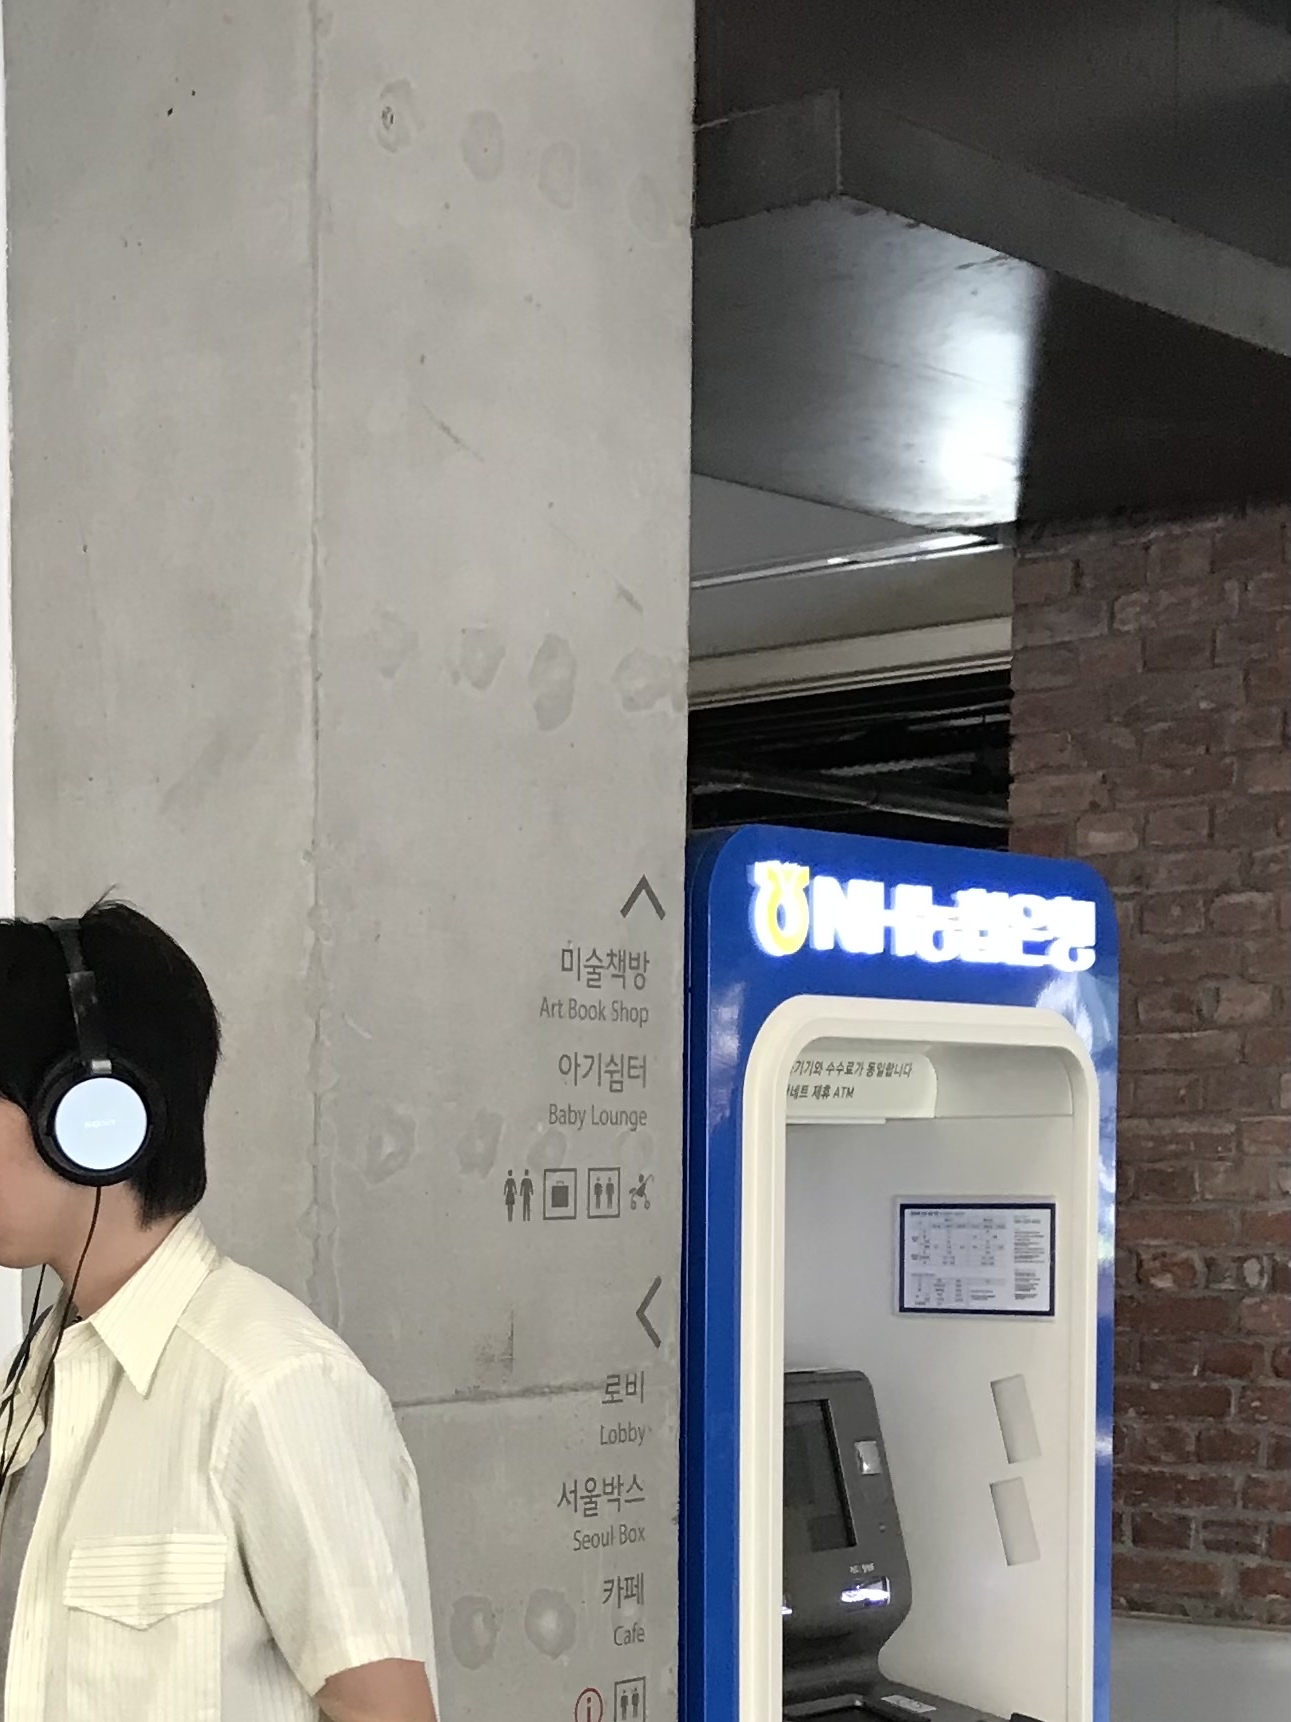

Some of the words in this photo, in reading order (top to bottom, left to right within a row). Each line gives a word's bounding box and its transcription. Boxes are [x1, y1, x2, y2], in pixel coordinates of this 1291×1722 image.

[560, 946, 651, 991] 미술책방
[539, 996, 564, 1020] Art
[567, 998, 607, 1023] Book
[611, 1000, 649, 1028] Shop
[558, 1051, 647, 1093] 아기쉼터
[789, 1060, 823, 1077] 기기와
[787, 1084, 809, 1100] 네트
[833, 1086, 855, 1100] ATM
[548, 1103, 587, 1131] Baby
[591, 1104, 648, 1132] Lounge
[601, 1370, 645, 1405] 로비
[600, 1423, 646, 1447] Lobby
[556, 1473, 646, 1518] 서울박스
[572, 1525, 614, 1552] Seoul
[618, 1522, 646, 1546] Box
[602, 1572, 645, 1609] 카페
[613, 1622, 646, 1648] Cafe
